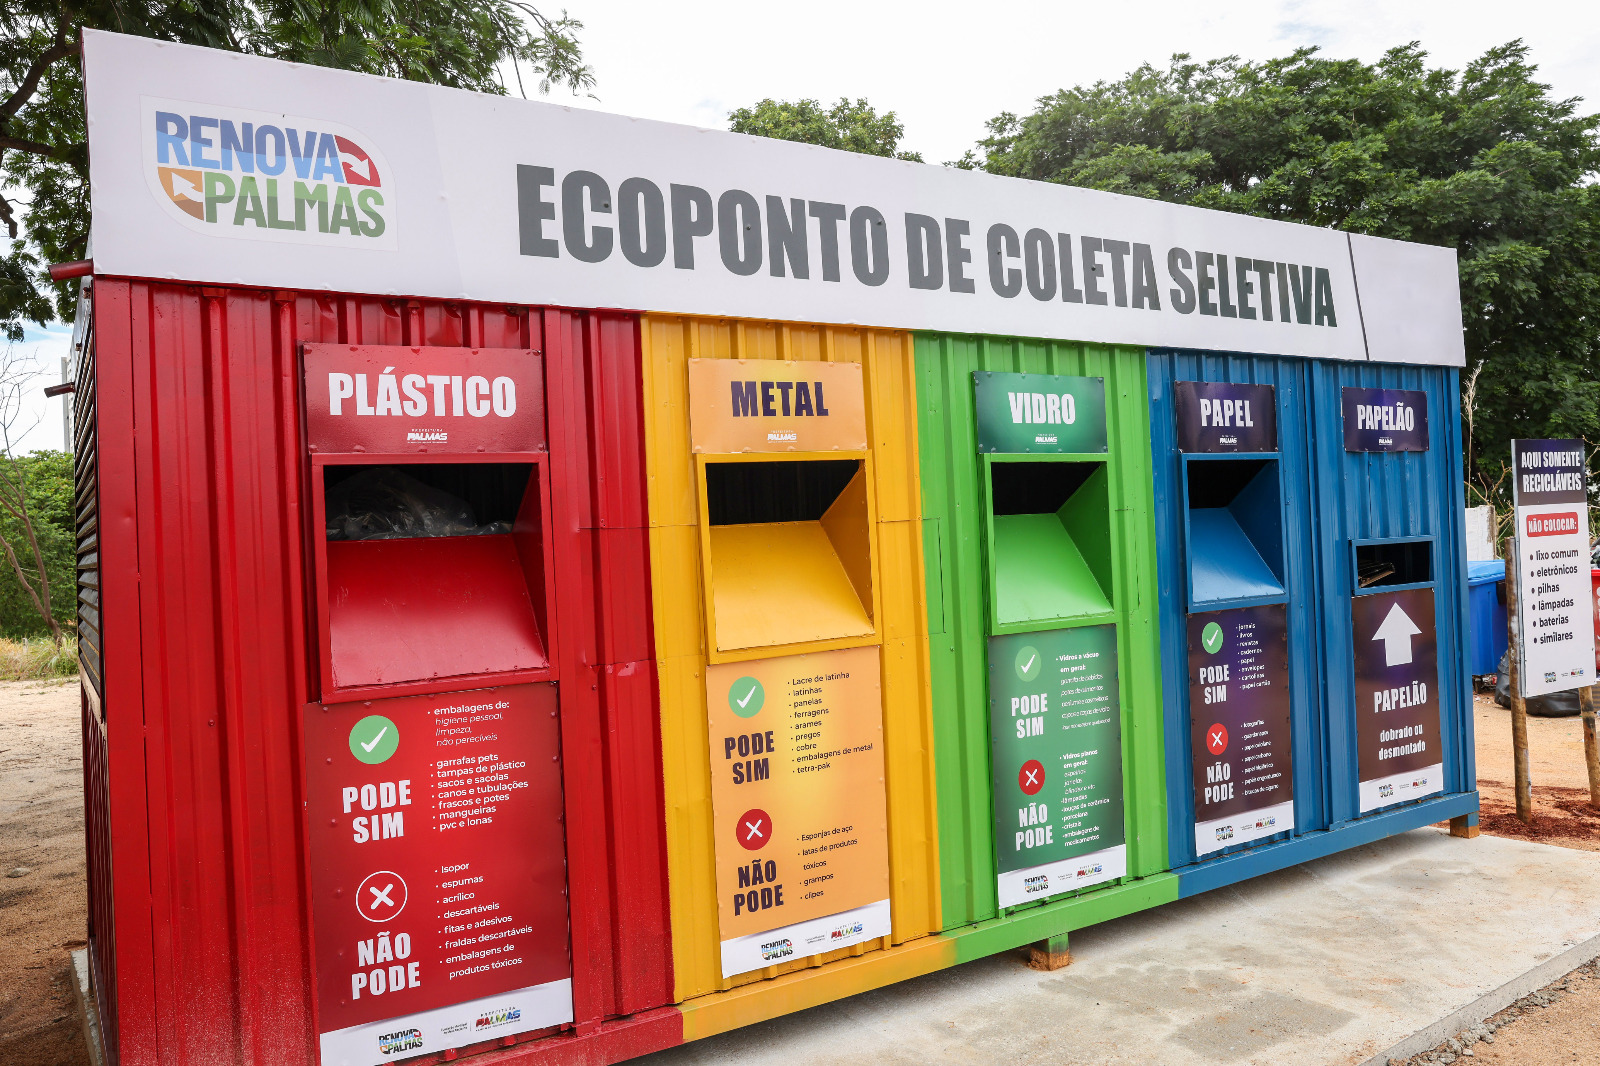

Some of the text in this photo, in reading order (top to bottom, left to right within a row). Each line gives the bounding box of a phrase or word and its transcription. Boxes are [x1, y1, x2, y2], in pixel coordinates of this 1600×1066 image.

[156, 110, 344, 184] RENOVA
[204, 171, 386, 238] PALMAS
[517, 164, 1337, 328] ECOPONTO DE COLETA SELETIVA
[328, 366, 516, 418] PLÁSTICO
[731, 381, 828, 417] METAL
[1008, 392, 1076, 424] VIDRO
[1200, 398, 1254, 427] PAPEL
[1357, 402, 1414, 432] PAPELÃO
[407, 432, 448, 440] PALMAS
[1522, 451, 1580, 470] AQUI SOMENTE
[1522, 470, 1582, 492] RECICLÁVEIS
[1528, 518, 1577, 533] NÃO COLOCAR:
[1536, 550, 1578, 562] lixo comum
[1536, 564, 1578, 578] eletrônicos
[1538, 582, 1560, 596] pilhas
[1538, 598, 1574, 612] lâmpadas
[1539, 614, 1569, 628] baterias
[1540, 630, 1573, 645] similares
[826, 672, 850, 681] latinha
[1200, 664, 1230, 684] PODE
[793, 687, 822, 696] latinhas
[1204, 685, 1226, 704] SIM
[1374, 680, 1427, 714] PAPELÃO
[434, 701, 510, 716] embalagens de:
[794, 698, 822, 708] panelas
[1011, 693, 1048, 716] PODE
[436, 712, 504, 726] higiene pessoal,
[794, 708, 830, 718] ferragens
[436, 726, 472, 736] limpeza,
[795, 720, 822, 730] arames
[1016, 716, 1044, 738] SIM
[1380, 724, 1422, 743] dobrado ou
[436, 732, 498, 746] não perecíveis
[724, 730, 774, 760] PODE
[796, 732, 820, 742] pregos
[796, 743, 816, 752] cobre
[796, 750, 841, 762] embalagens
[853, 743, 873, 752] metal
[1378, 739, 1426, 760] desmontado
[436, 754, 498, 770] garrafas pets
[437, 760, 526, 778] tampas de plástico
[797, 762, 831, 774] tetra-pak
[732, 758, 770, 784] SIM
[1206, 762, 1230, 784] NÃO
[438, 778, 464, 788] sacos
[474, 772, 508, 784] sacolas
[342, 780, 412, 813] PODE
[438, 788, 466, 799] canos
[477, 780, 528, 794] tubulações
[1204, 782, 1234, 804] PODE
[438, 798, 474, 809] frascos
[484, 793, 510, 804] potes
[440, 805, 496, 820] mangueiras
[1018, 802, 1048, 828] NÃO
[352, 812, 404, 844] SIM
[440, 822, 457, 832] pvc
[468, 816, 492, 826] lonas
[802, 830, 830, 841] Esponjas
[1016, 825, 1054, 851] PODE
[802, 847, 818, 856] latas
[829, 838, 858, 851] produtos
[442, 863, 470, 874] Isopor
[738, 858, 776, 888] NÃO
[803, 860, 826, 870] tóxicos
[442, 876, 484, 888] espumas
[804, 874, 834, 886] grampos
[442, 892, 474, 904] acrílico
[734, 884, 784, 916] PODE
[804, 890, 824, 900] clipes
[444, 902, 500, 918] descartáveis
[444, 923, 465, 934] fitas
[474, 915, 512, 928] adesivos
[831, 924, 862, 938] PALMAS
[445, 925, 532, 949] fraldas descartáveis
[761, 939, 786, 952] RENOVA
[358, 931, 411, 967] NÃO
[446, 944, 514, 964] embalagens de
[768, 946, 794, 960] PALMAS
[449, 957, 522, 980] produtos tóxicos
[352, 962, 420, 1000] PODE
[476, 1010, 520, 1027] PALMAS
[378, 1028, 416, 1046] RENOVA
[388, 1037, 422, 1054] PALMAS
